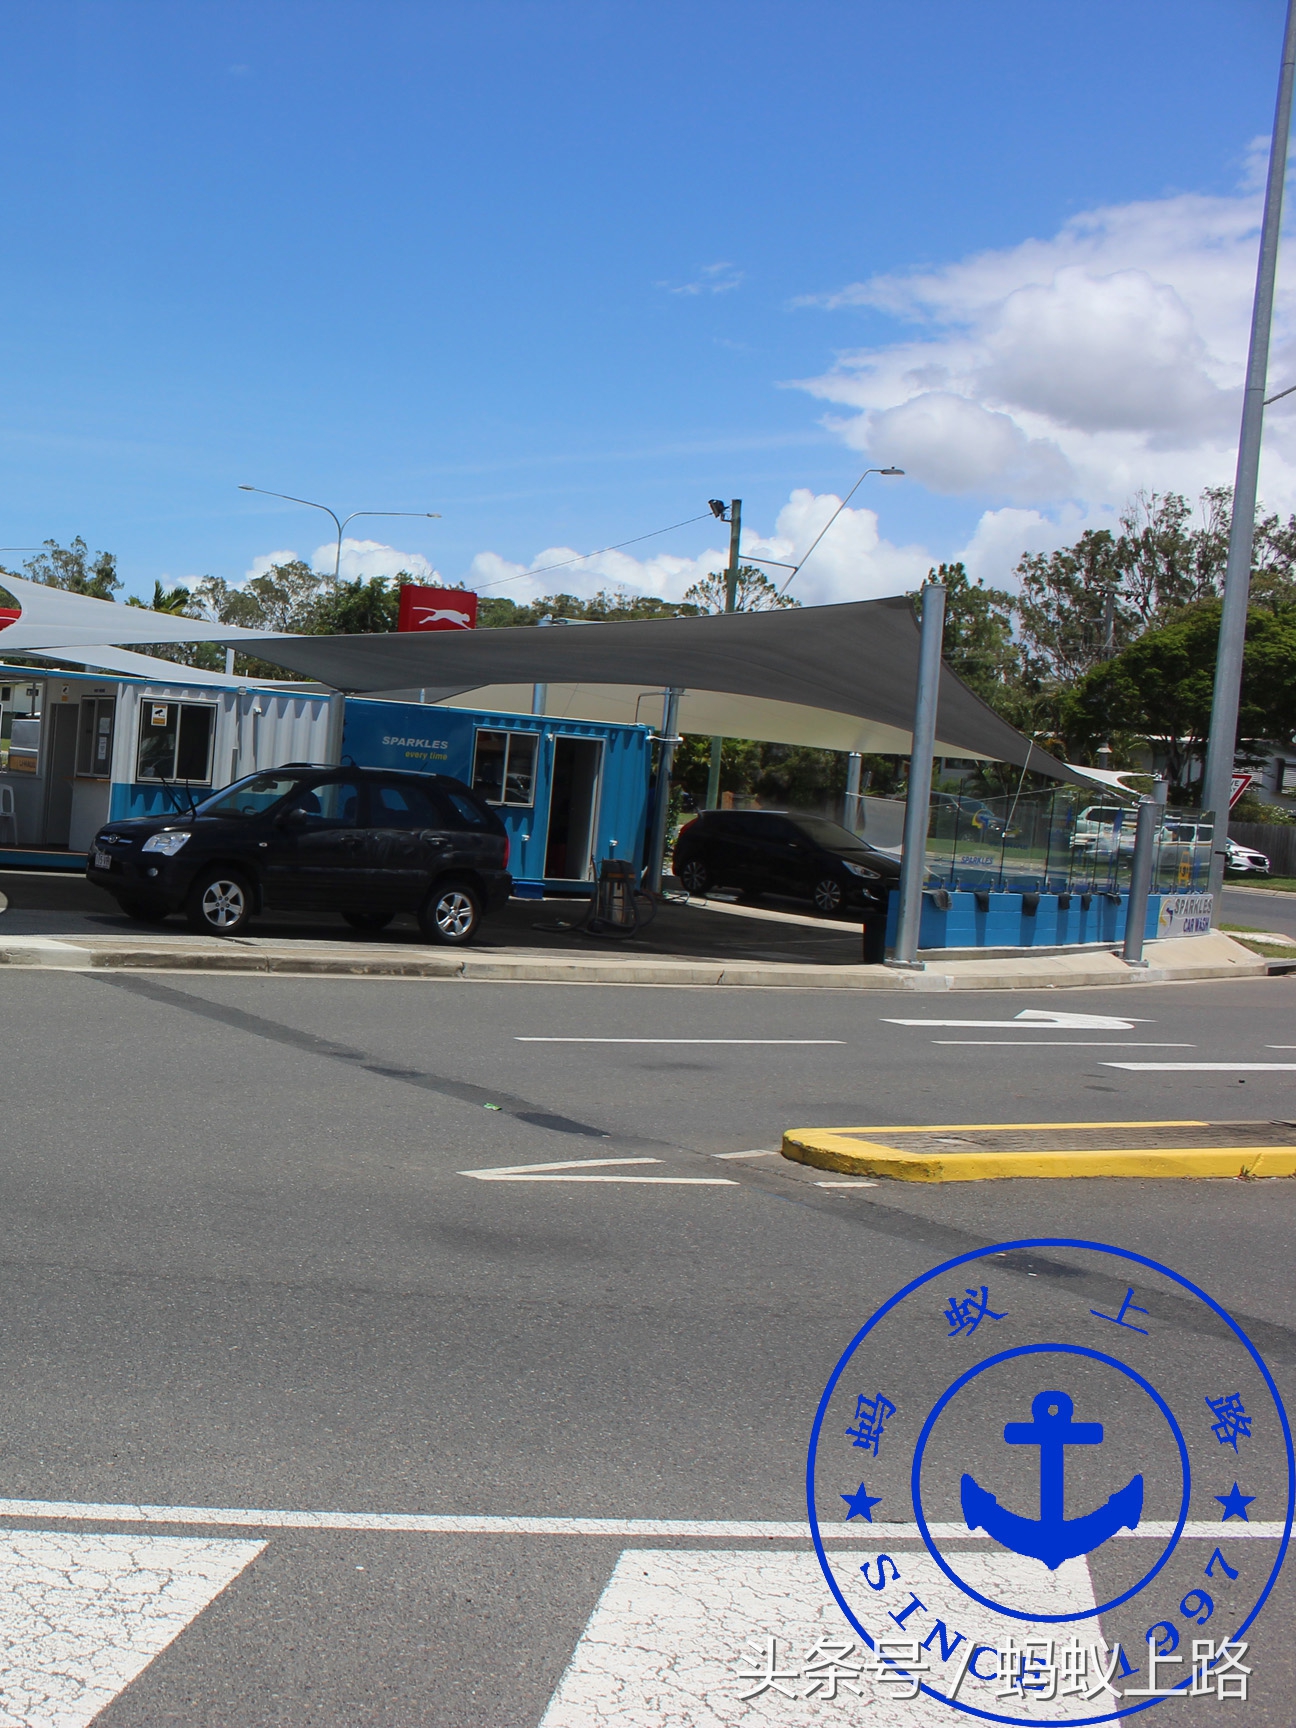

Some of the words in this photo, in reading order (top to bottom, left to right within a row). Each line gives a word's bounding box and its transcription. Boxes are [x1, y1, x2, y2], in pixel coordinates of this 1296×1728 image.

[382, 736, 448, 750] SPARKLES
[405, 751, 428, 760] every
[429, 751, 448, 760] time
[1174, 898, 1213, 915] SPARKLES
